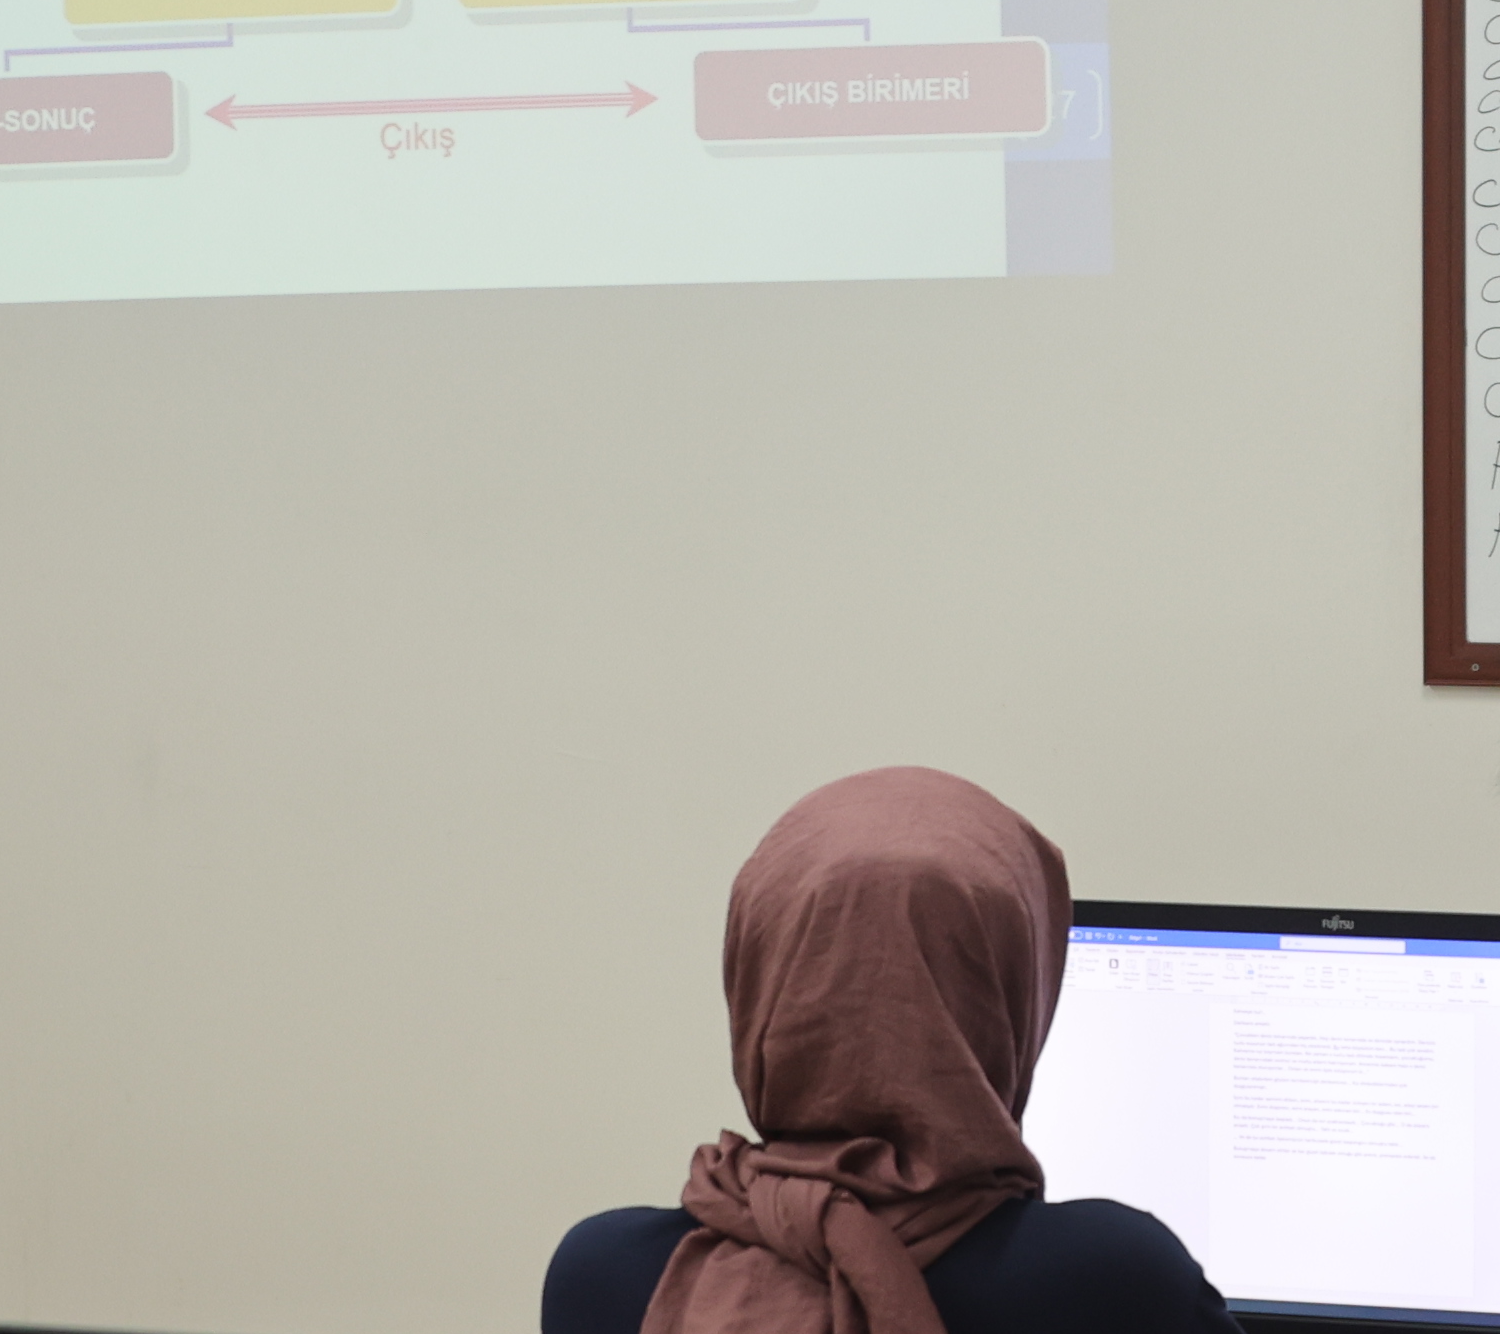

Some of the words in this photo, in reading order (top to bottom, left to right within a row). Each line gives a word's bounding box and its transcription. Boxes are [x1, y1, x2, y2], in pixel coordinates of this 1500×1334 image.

[766, 79, 839, 110] ÇIKIŞ
[846, 69, 971, 104] BİRİMERİ
[379, 122, 456, 158] Çıkış
